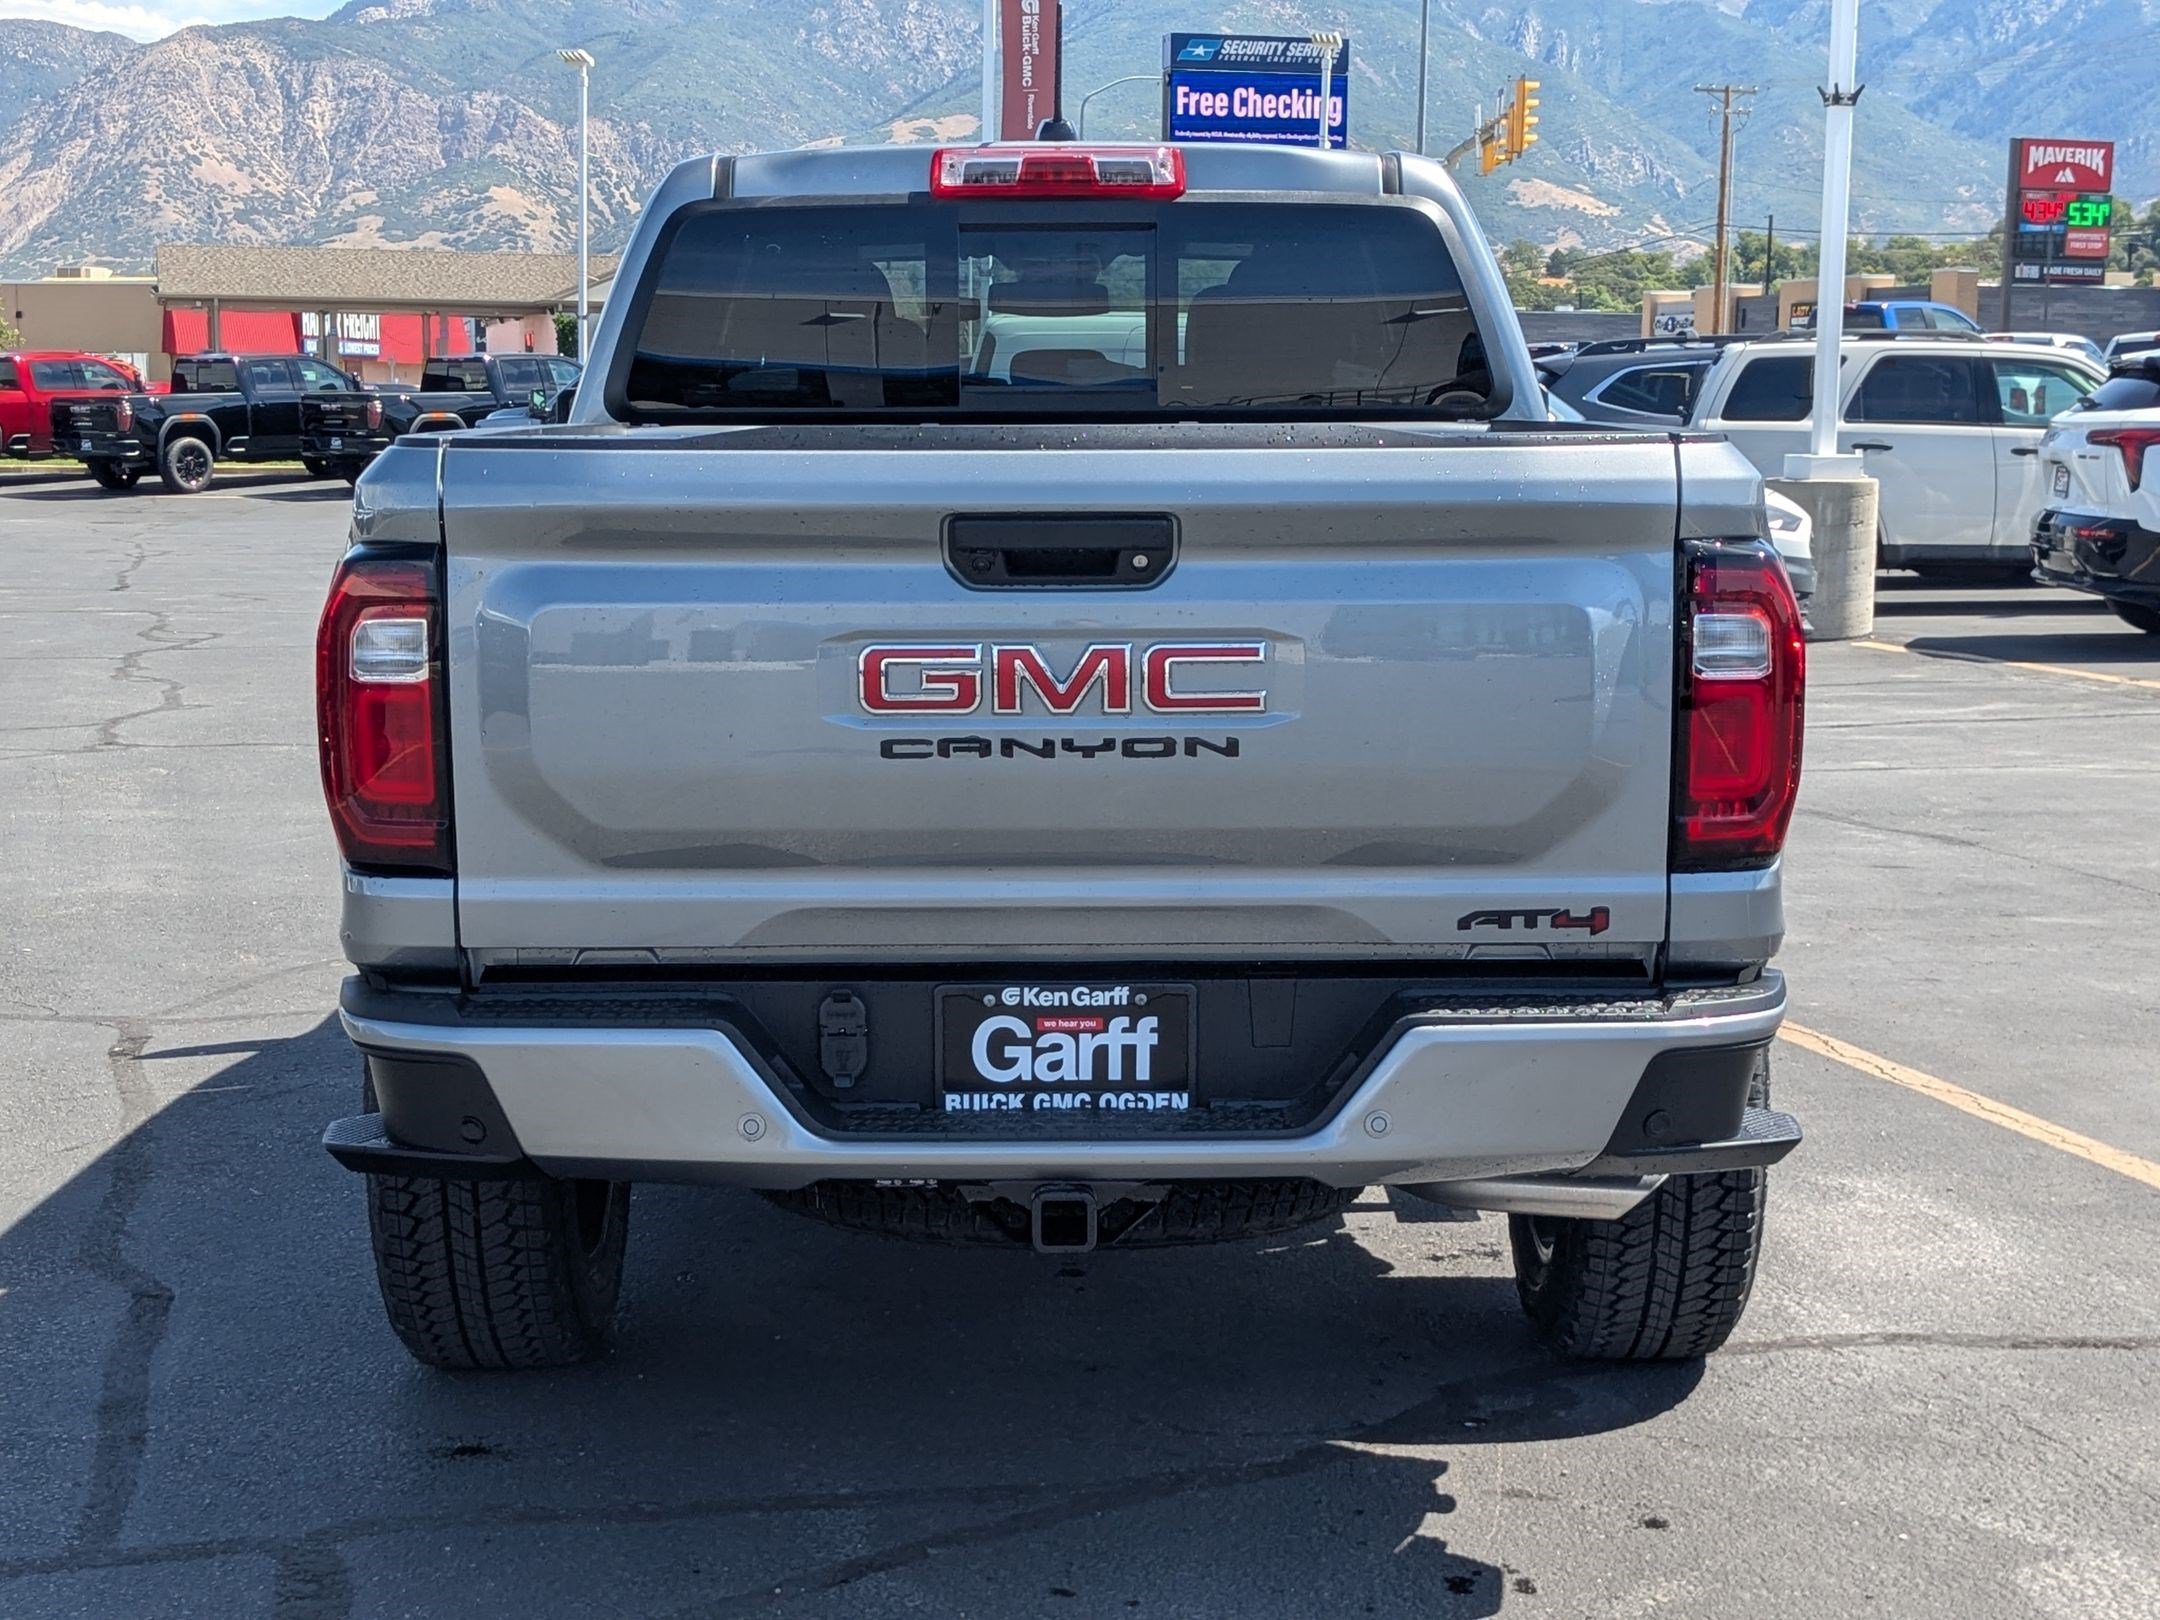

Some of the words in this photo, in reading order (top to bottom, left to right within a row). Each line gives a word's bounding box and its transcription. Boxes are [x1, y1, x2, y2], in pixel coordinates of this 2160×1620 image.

[1032, 34, 1040, 55] Garff
[1221, 39, 1286, 56] SECURITY
[1286, 41, 1341, 58] SERVIE
[1218, 54, 1261, 62] FEDERAL
[1176, 86, 1229, 117] Free
[1233, 87, 1343, 127] Checking
[2027, 145, 2106, 177] MAVERIK
[857, 641, 1267, 716] GMC
[879, 735, 1240, 759] CANYON
[1457, 905, 1610, 936] AT4
[1023, 987, 1068, 1007] Ken
[1071, 986, 1130, 1007] Garff
[1043, 1020, 1057, 1028] we
[1058, 1018, 1078, 1028] hear
[1079, 1020, 1097, 1030] you
[971, 1014, 1159, 1083] Garff
